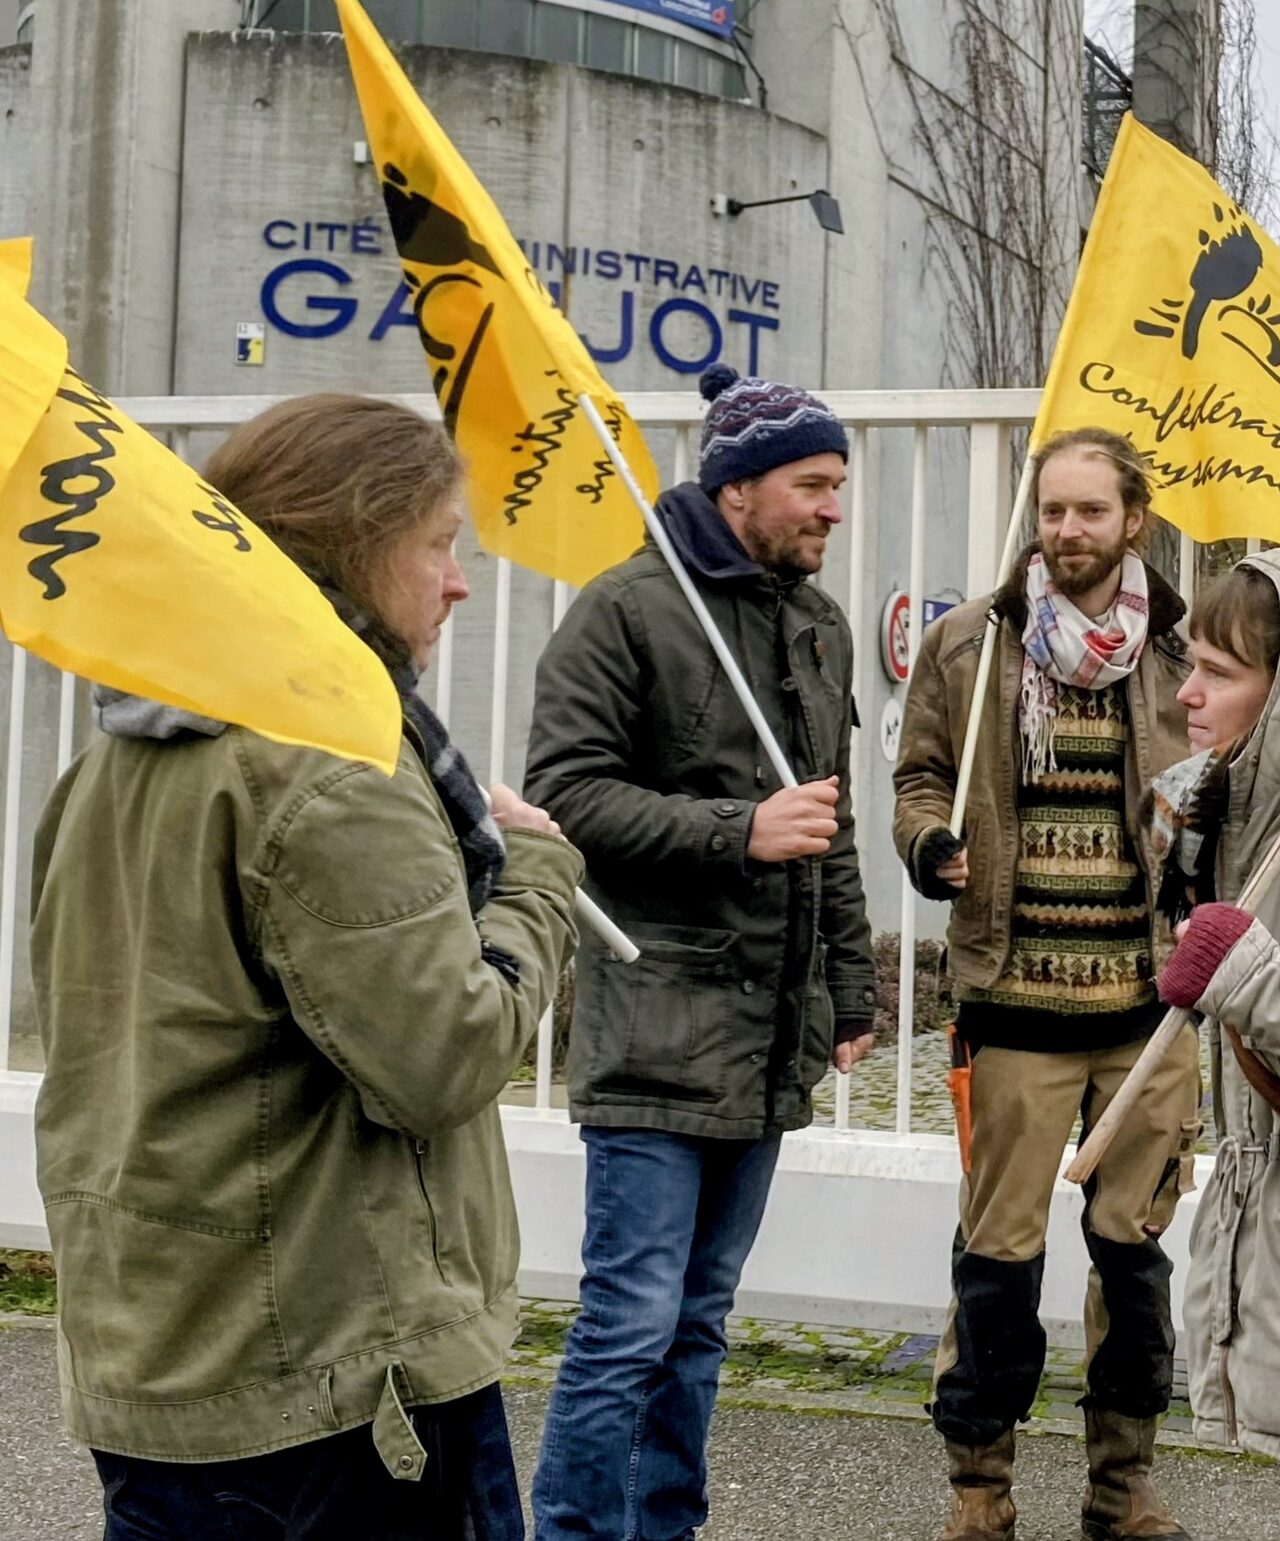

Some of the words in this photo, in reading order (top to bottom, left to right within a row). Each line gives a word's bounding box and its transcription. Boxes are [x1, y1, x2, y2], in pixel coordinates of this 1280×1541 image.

[263, 216, 383, 254] CITÉ
[519, 239, 780, 308] INISTRATIVE
[260, 258, 780, 377] GJOT
